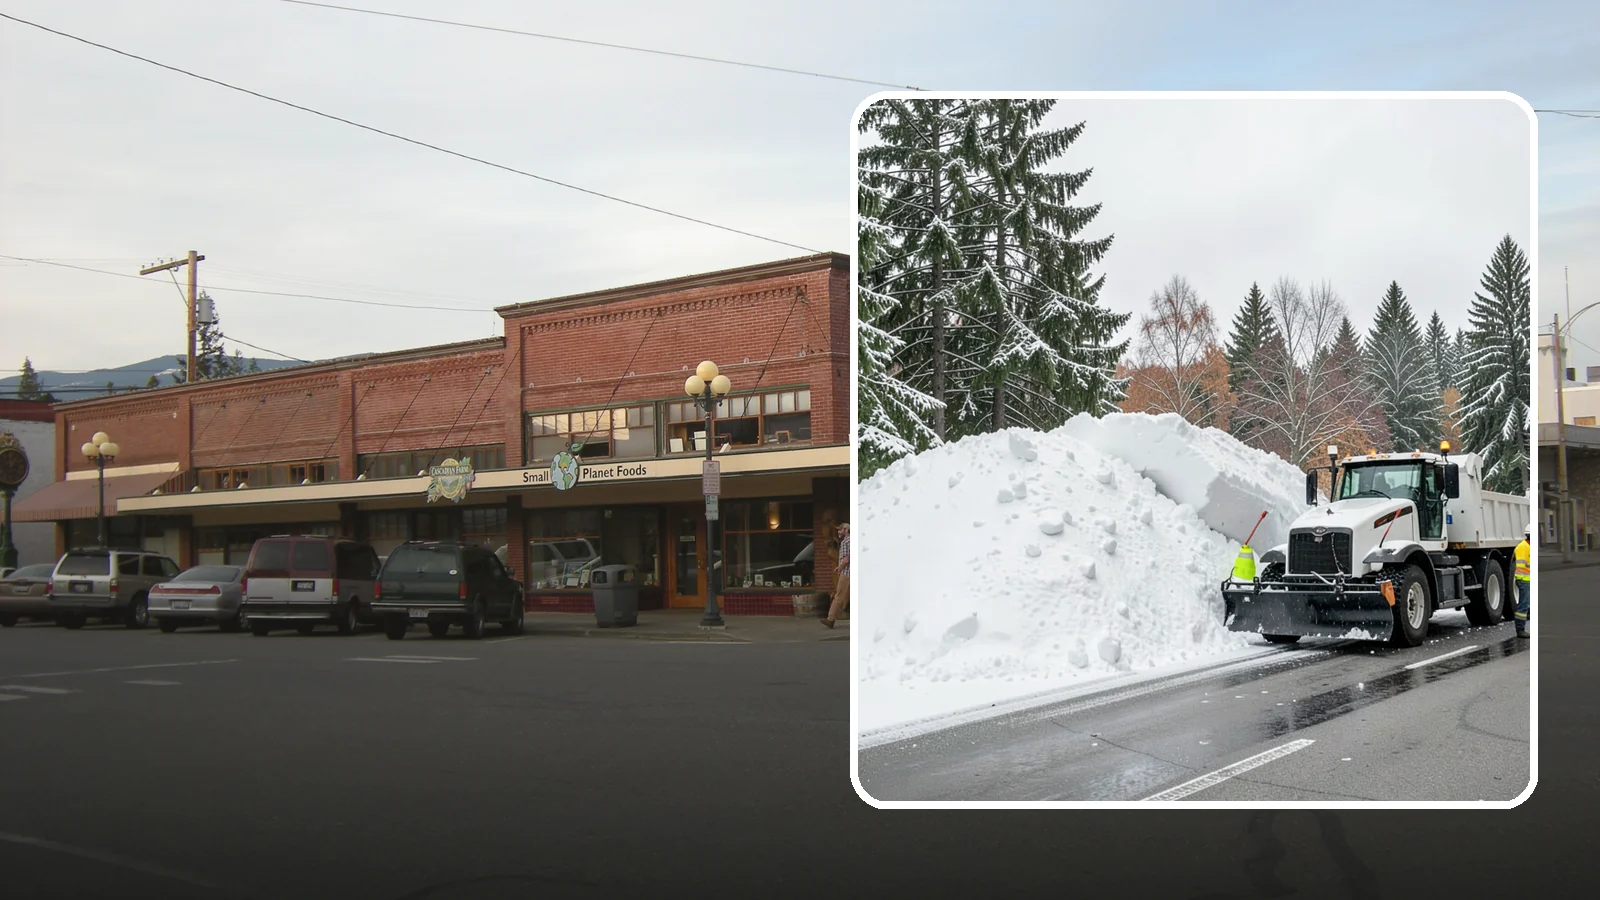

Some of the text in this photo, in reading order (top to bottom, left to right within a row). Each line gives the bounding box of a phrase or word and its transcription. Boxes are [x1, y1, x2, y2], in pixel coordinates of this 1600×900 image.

[523, 464, 647, 483] Small Planet Foods
